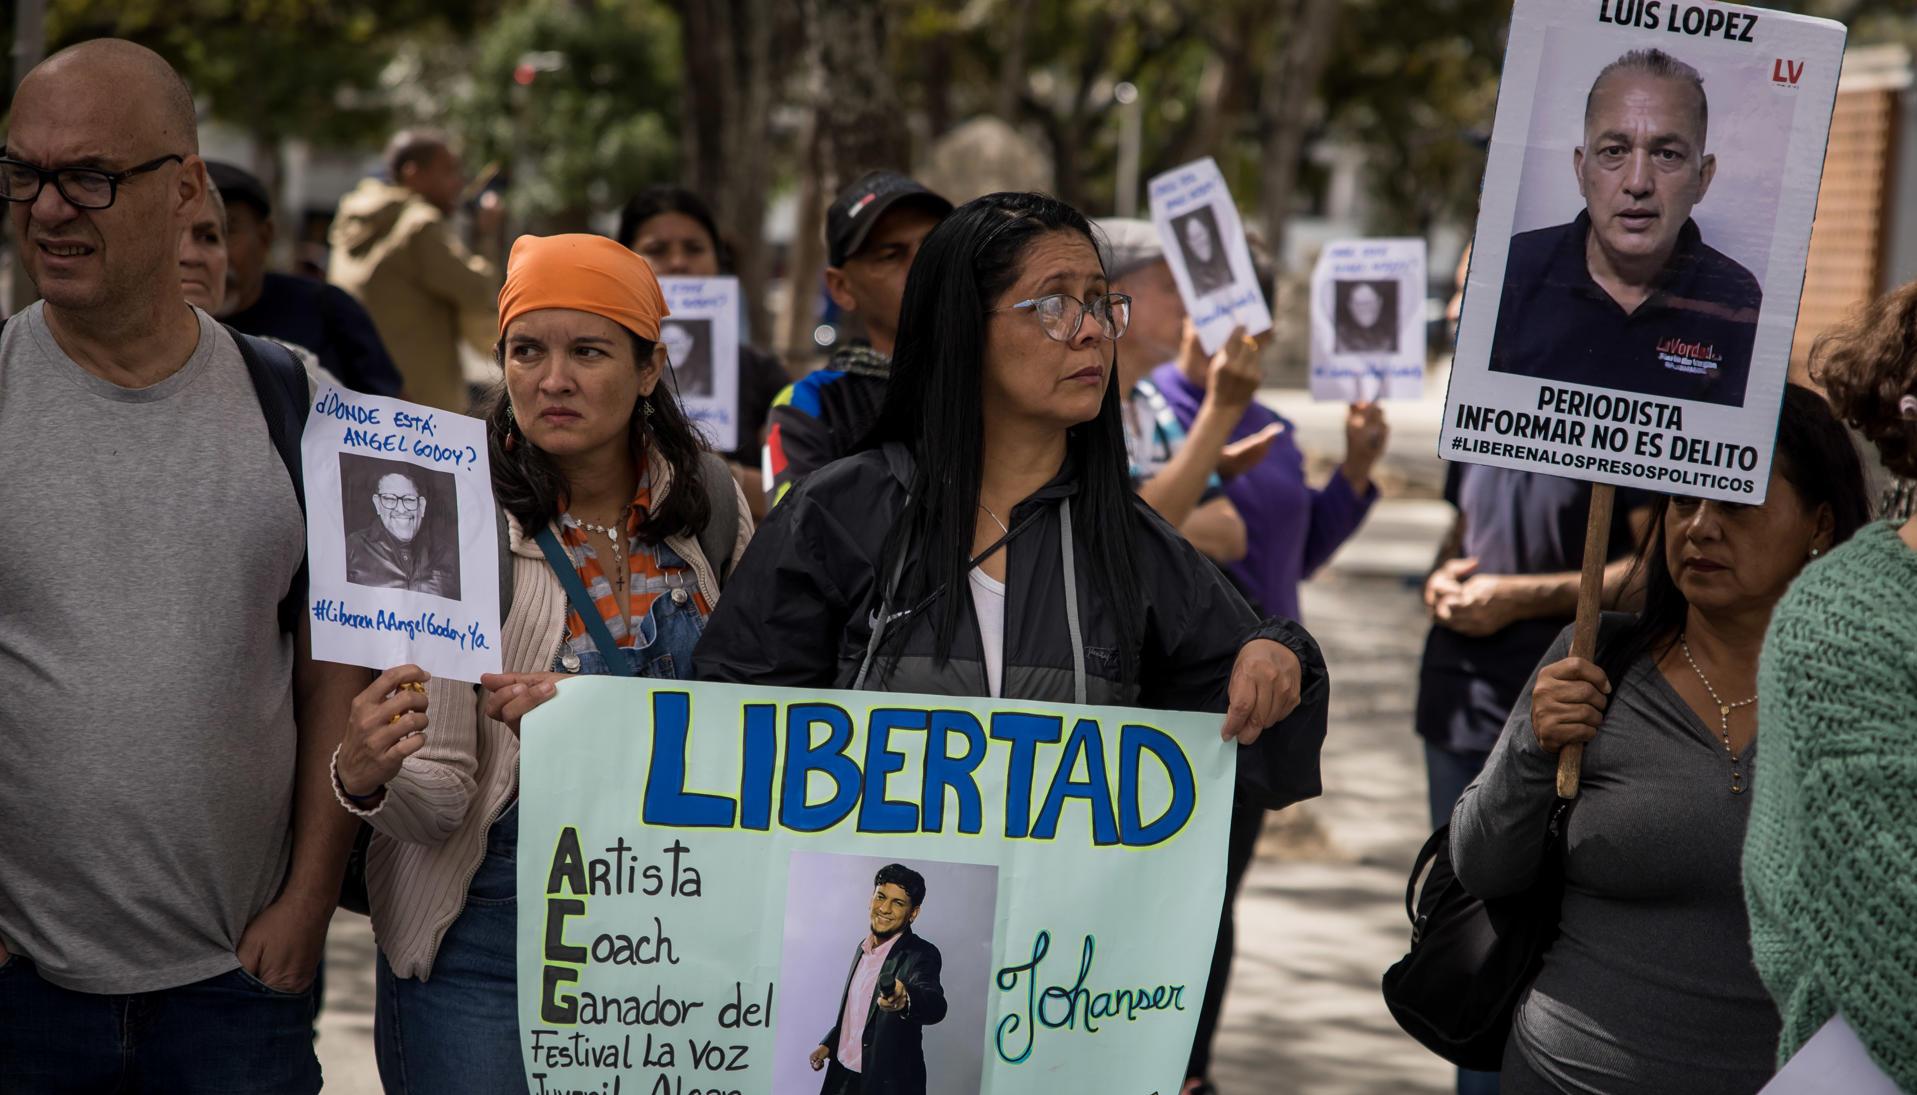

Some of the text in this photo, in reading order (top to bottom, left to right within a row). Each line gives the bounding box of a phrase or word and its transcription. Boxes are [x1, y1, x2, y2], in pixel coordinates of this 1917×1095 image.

[1599, 0, 1758, 43] LUIS LOPEZ
[1772, 58, 1804, 84] LV
[1537, 385, 1682, 431] PERIODISTA
[343, 427, 477, 471] ANGEL GODOY?
[1451, 436, 1755, 494] #LIBERENALOSPRESOSPOLITICOS
[1455, 404, 1758, 472] INFORMAR NO ES DELITO
[641, 690, 1196, 846] LIBERTAD
[544, 898, 680, 965] Coach
[540, 965, 774, 1028] Ganador del
[996, 930, 1186, 1064] Johanser
[643, 1033, 675, 1067] La
